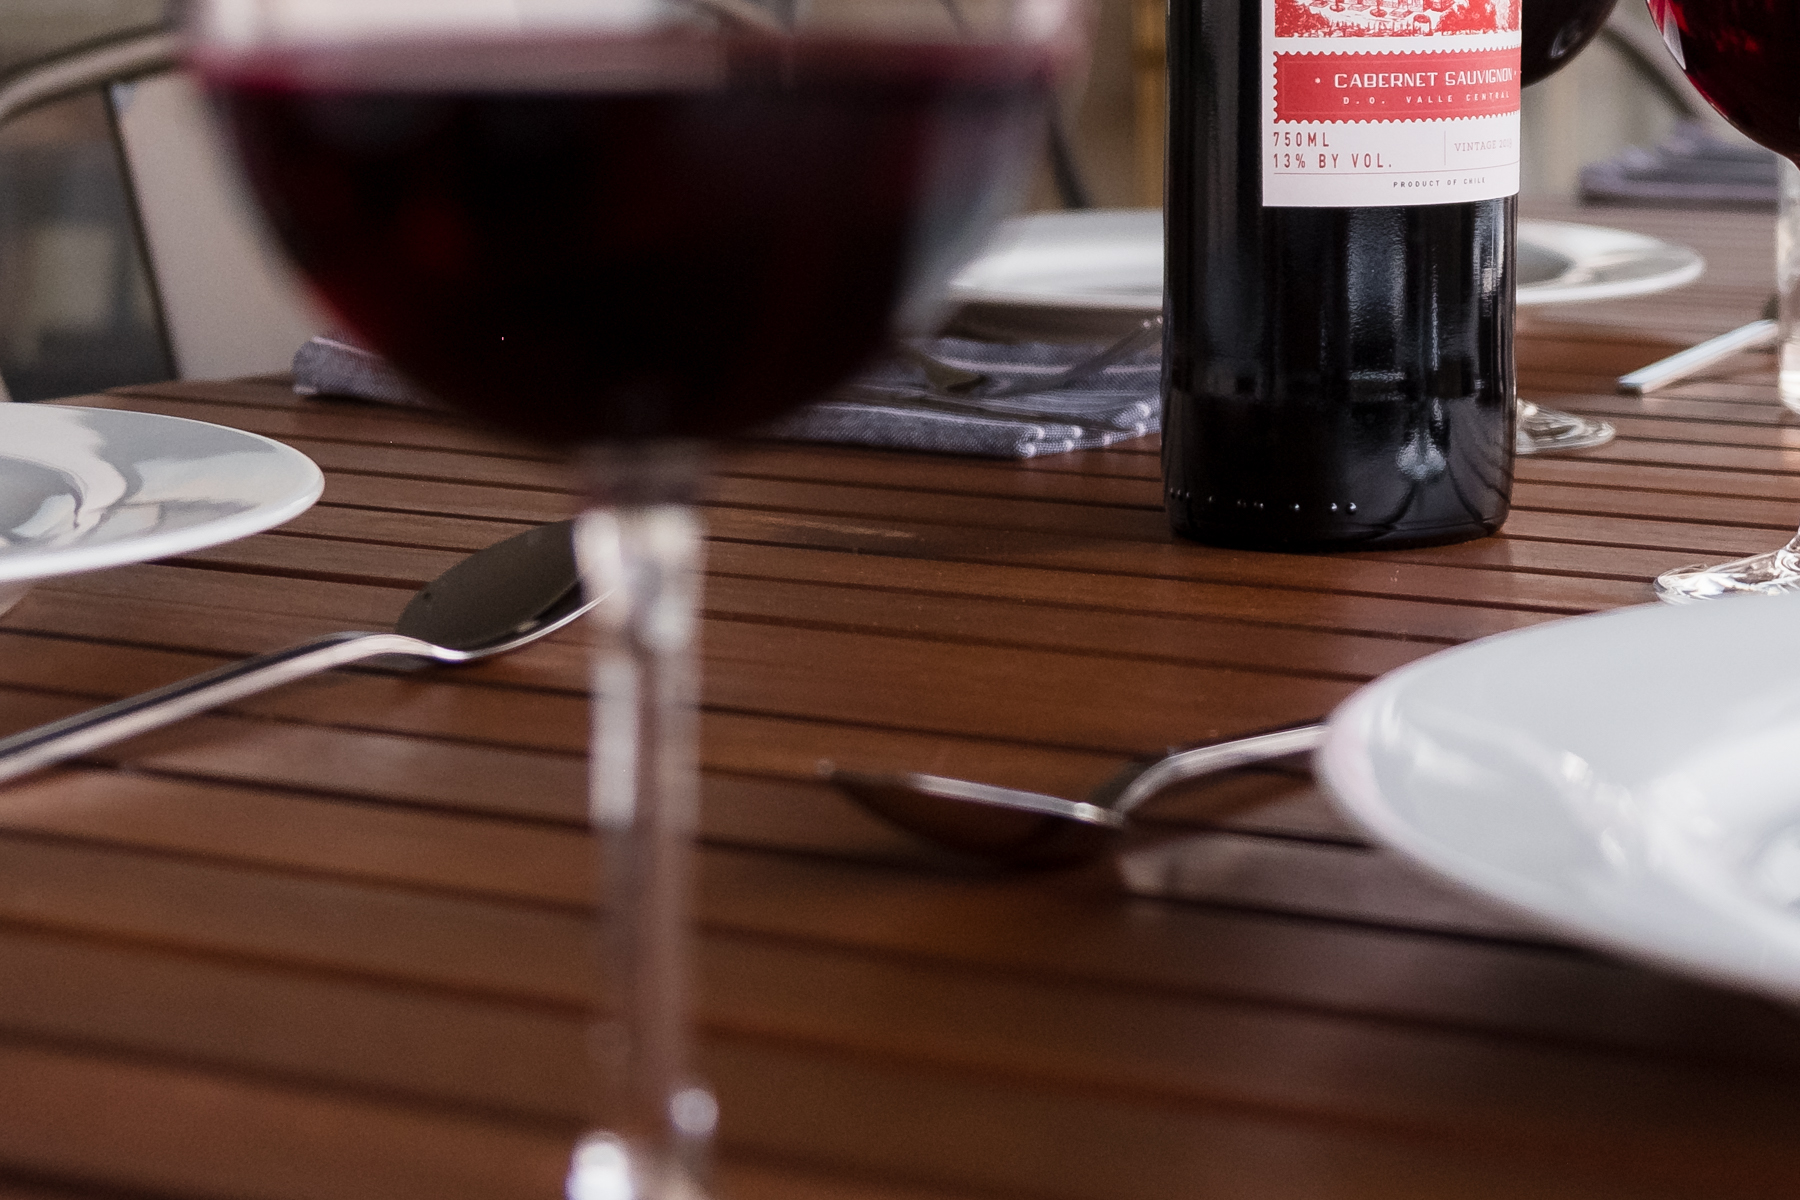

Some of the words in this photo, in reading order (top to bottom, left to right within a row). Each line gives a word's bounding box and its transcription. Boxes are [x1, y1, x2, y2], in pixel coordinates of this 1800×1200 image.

[1334, 71, 1438, 88] CABERNET
[1445, 68, 1513, 86] SAUVIGNON
[1406, 94, 1453, 104] VALLE
[1466, 91, 1510, 102] CENTRAL
[1273, 131, 1330, 147] 750ML
[1454, 139, 1497, 152] VINTAGE
[1273, 153, 1306, 168] 13%
[1318, 153, 1339, 169] BY
[1351, 152, 1393, 168] VOL.
[1393, 179, 1441, 188] PRODUCT
[1463, 176, 1486, 185] CHILE
